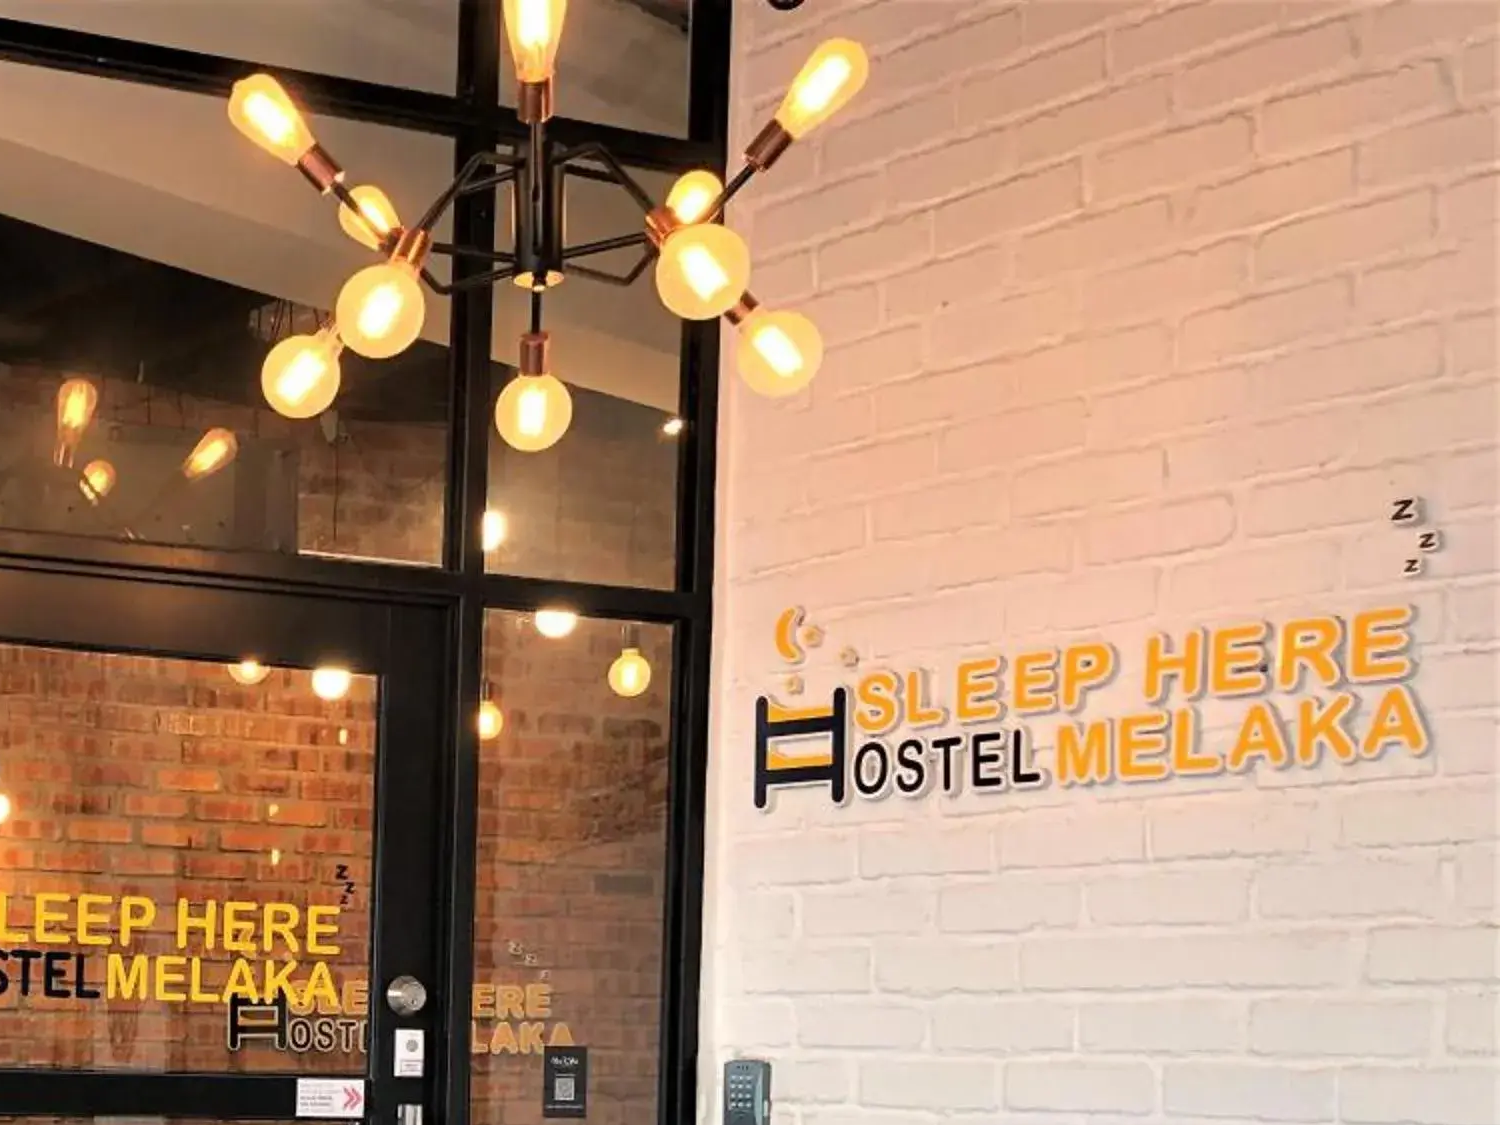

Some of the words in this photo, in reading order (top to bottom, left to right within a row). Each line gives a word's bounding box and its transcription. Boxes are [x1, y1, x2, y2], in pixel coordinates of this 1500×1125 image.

[855, 643, 1115, 732] SLEEP
[1143, 607, 1411, 699] HERE
[1056, 687, 1426, 783] MELAKA
[176, 897, 341, 955] HERE
[106, 953, 340, 1006] MELAKA
[472, 984, 552, 1020] ERE
